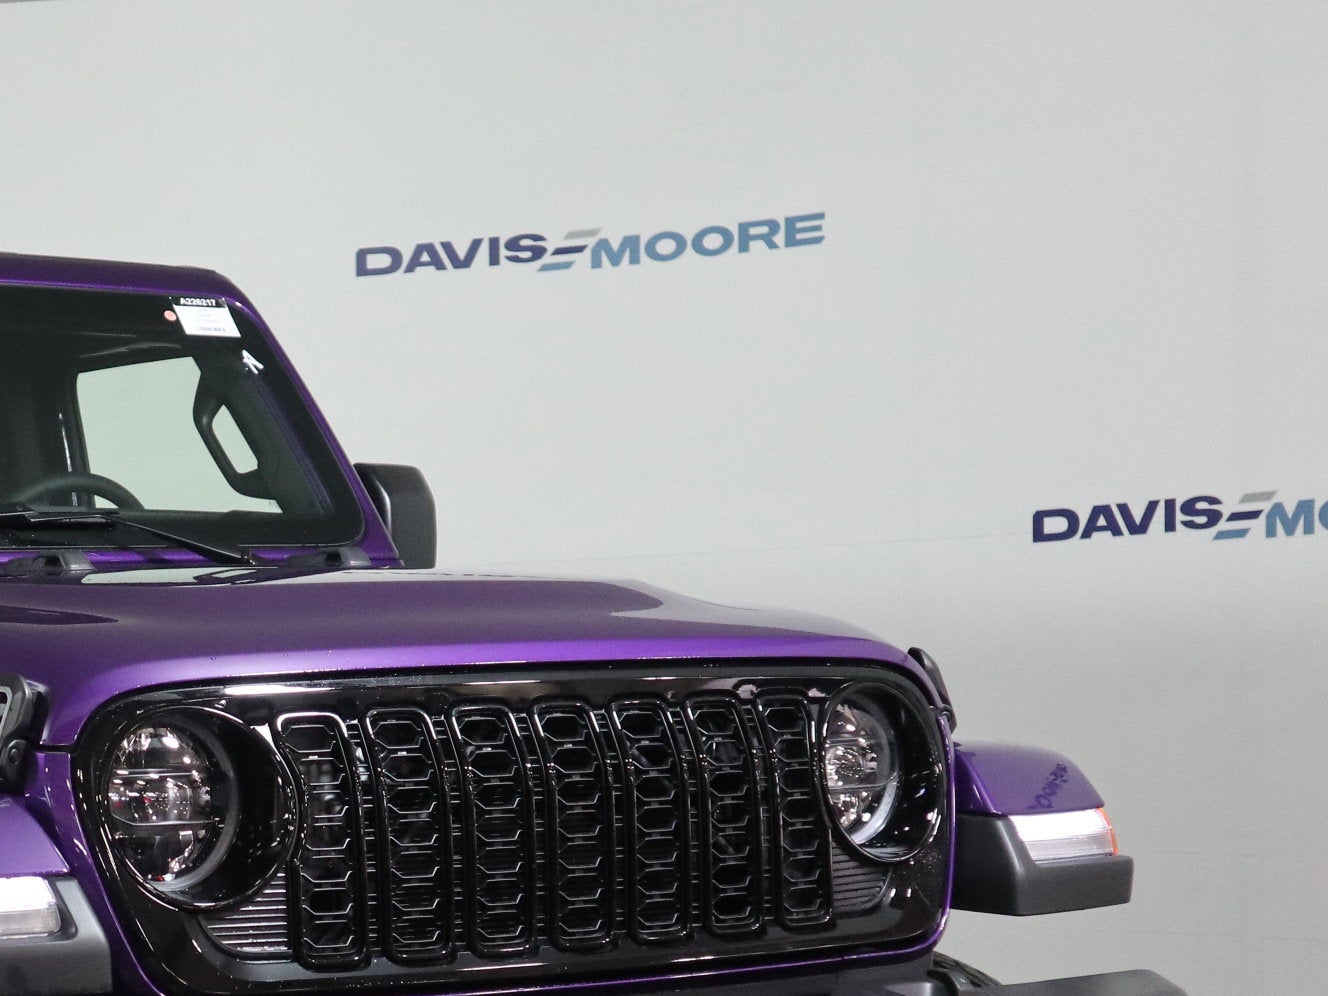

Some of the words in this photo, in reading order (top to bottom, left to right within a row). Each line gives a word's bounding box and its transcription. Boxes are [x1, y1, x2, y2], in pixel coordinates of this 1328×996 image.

[355, 233, 548, 277] DAVIS
[590, 211, 826, 269] MOORE
[1032, 495, 1224, 543] DAVIS
[1265, 498, 1328, 539] M
